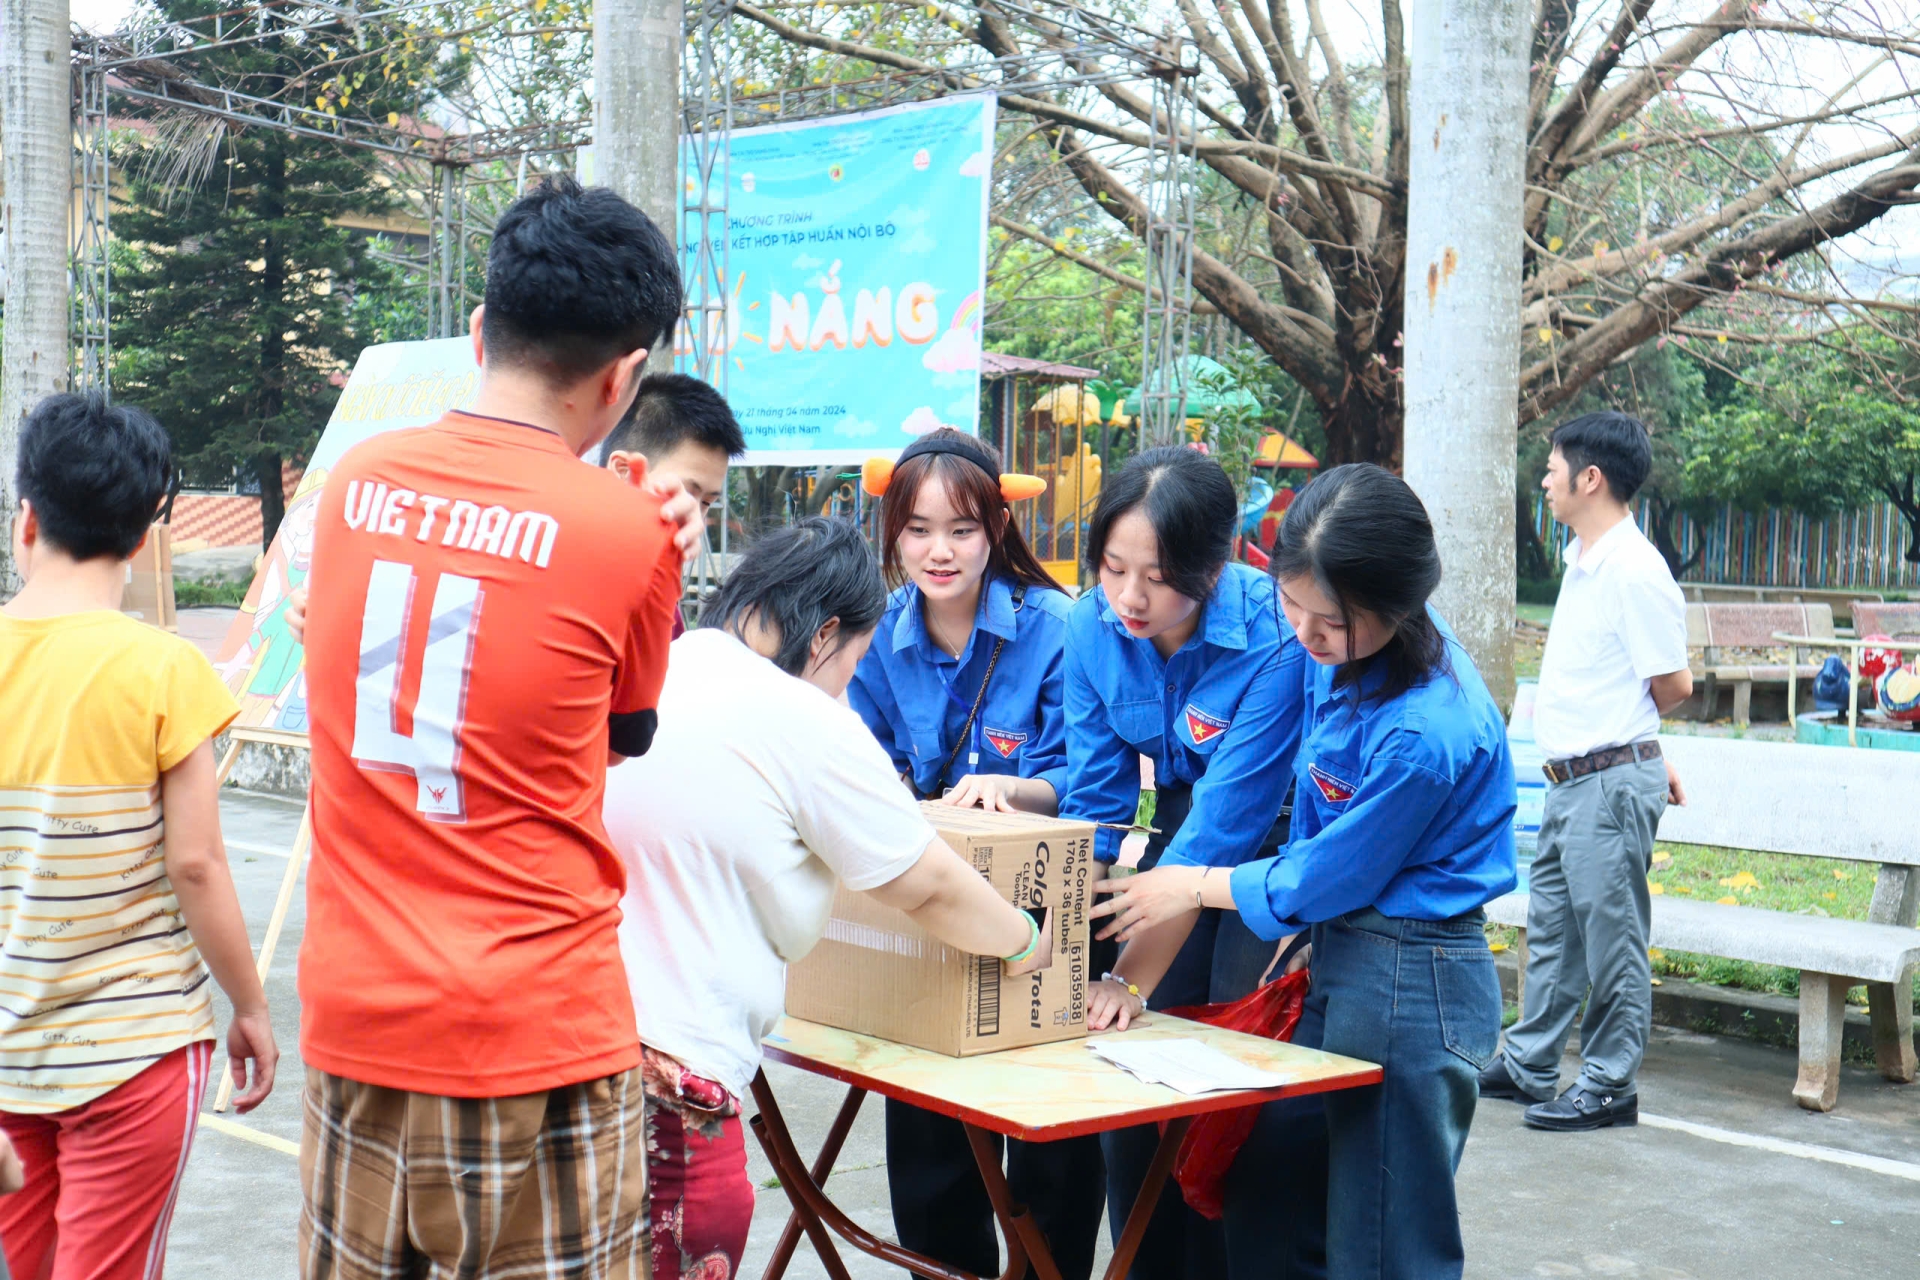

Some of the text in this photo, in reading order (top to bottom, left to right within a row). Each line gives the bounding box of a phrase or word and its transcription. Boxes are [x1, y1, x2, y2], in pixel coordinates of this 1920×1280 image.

[727, 210, 814, 230] HƯƠNG TRÌNH
[731, 234, 752, 250] KẾT
[754, 234, 779, 250] HỢP
[782, 230, 805, 247] TẬP
[808, 225, 844, 243] HUẤN
[847, 223, 871, 242] NỘI
[875, 221, 896, 238] BỘ
[768, 259, 939, 352] NẮNG
[757, 406, 784, 419] tháng
[822, 404, 846, 415] 2024
[755, 425, 776, 437] Nghị
[779, 423, 796, 437] Việt
[798, 425, 821, 434] Nam
[343, 480, 559, 569] VIETNAM
[351, 559, 485, 823] 4
[71, 820, 99, 834] Cute
[33, 867, 58, 879] Cute
[1012, 871, 1022, 908] Toothp
[1021, 862, 1030, 901] CLEAN
[1073, 838, 1090, 925] Net Content
[149, 908, 165, 920] Cut
[1061, 840, 1076, 955] 170g x 36 tubes
[49, 919, 74, 935] Cute
[1030, 841, 1050, 1029] Colg Total
[1070, 946, 1083, 1020] 61035938
[42, 1031, 97, 1048] Kitty Cute
